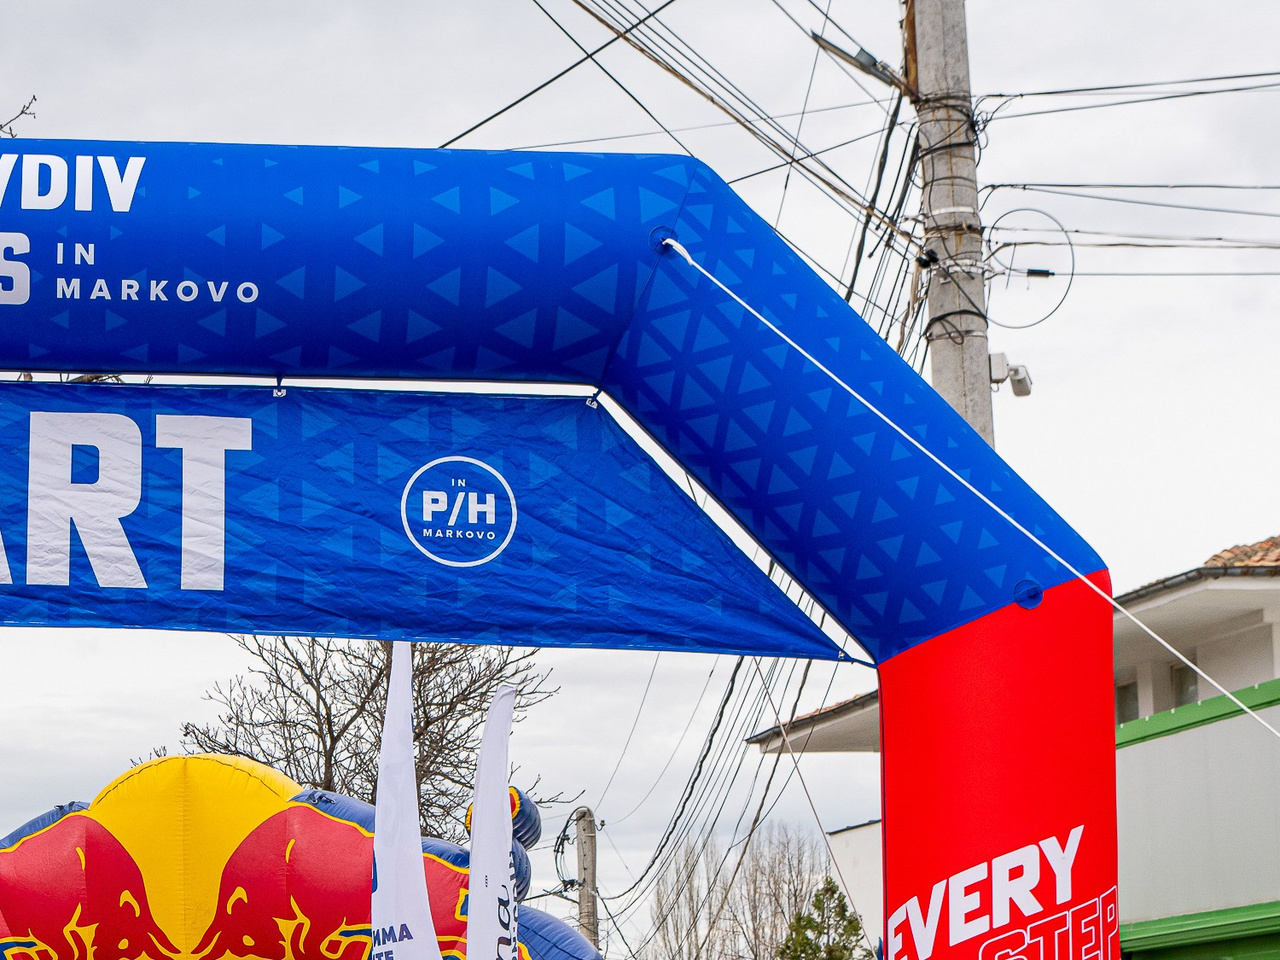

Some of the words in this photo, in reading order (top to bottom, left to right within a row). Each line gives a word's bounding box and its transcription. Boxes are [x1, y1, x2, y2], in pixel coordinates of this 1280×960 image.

[56, 242, 95, 266] IN
[55, 277, 260, 304] MARKOVO
[451, 478, 466, 487] IN
[422, 490, 496, 527] P/H
[422, 528, 496, 540] MARKOVO
